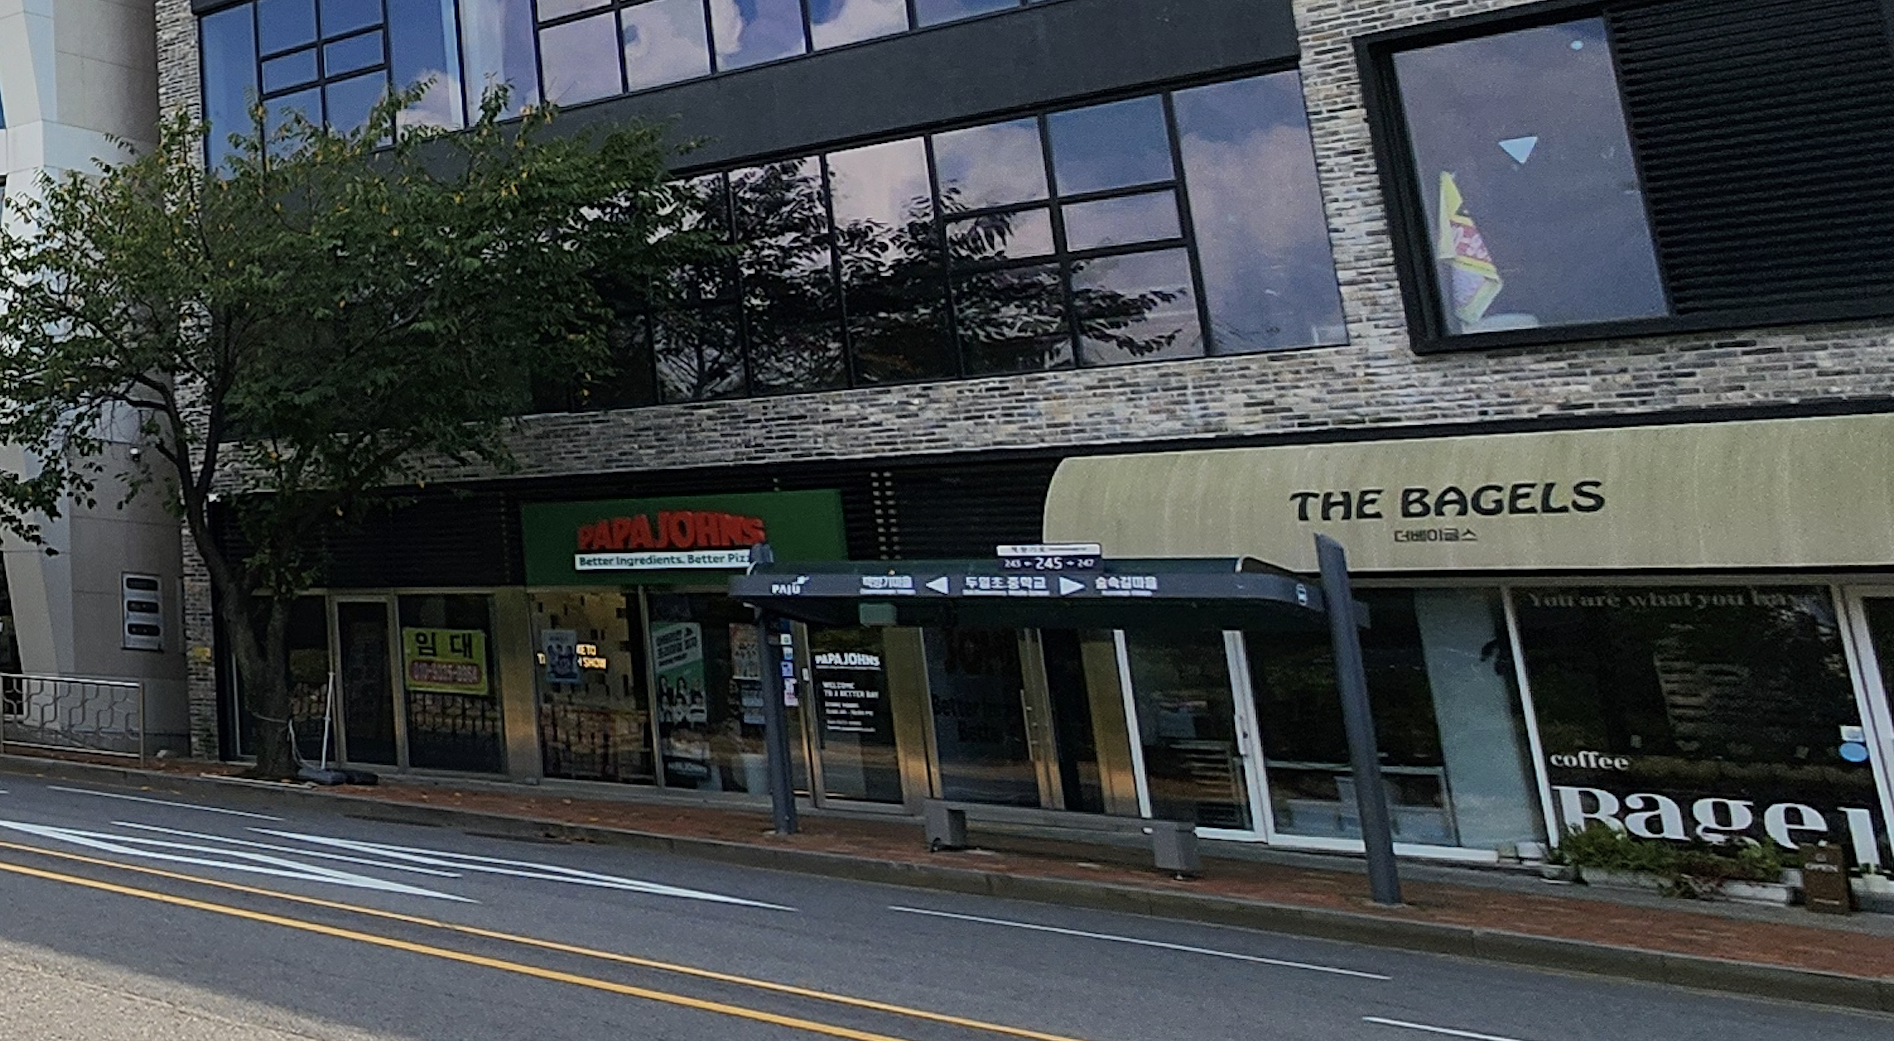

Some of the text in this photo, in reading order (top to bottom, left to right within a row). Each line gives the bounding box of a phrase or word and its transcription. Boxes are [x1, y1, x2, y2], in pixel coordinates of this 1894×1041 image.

[1290, 481, 1606, 521] THE BAGELS
[1394, 528, 1478, 543] 더베이글스
[579, 556, 614, 567] Better
[688, 553, 725, 565] Better
[728, 553, 751, 563] Piz
[1035, 557, 1063, 570] 245
[772, 583, 801, 595] PAJU
[1580, 595, 1620, 607] are
[1629, 592, 1692, 608] what
[1697, 594, 1744, 609] you
[415, 632, 473, 658] 임대
[1550, 750, 1629, 772] coffee
